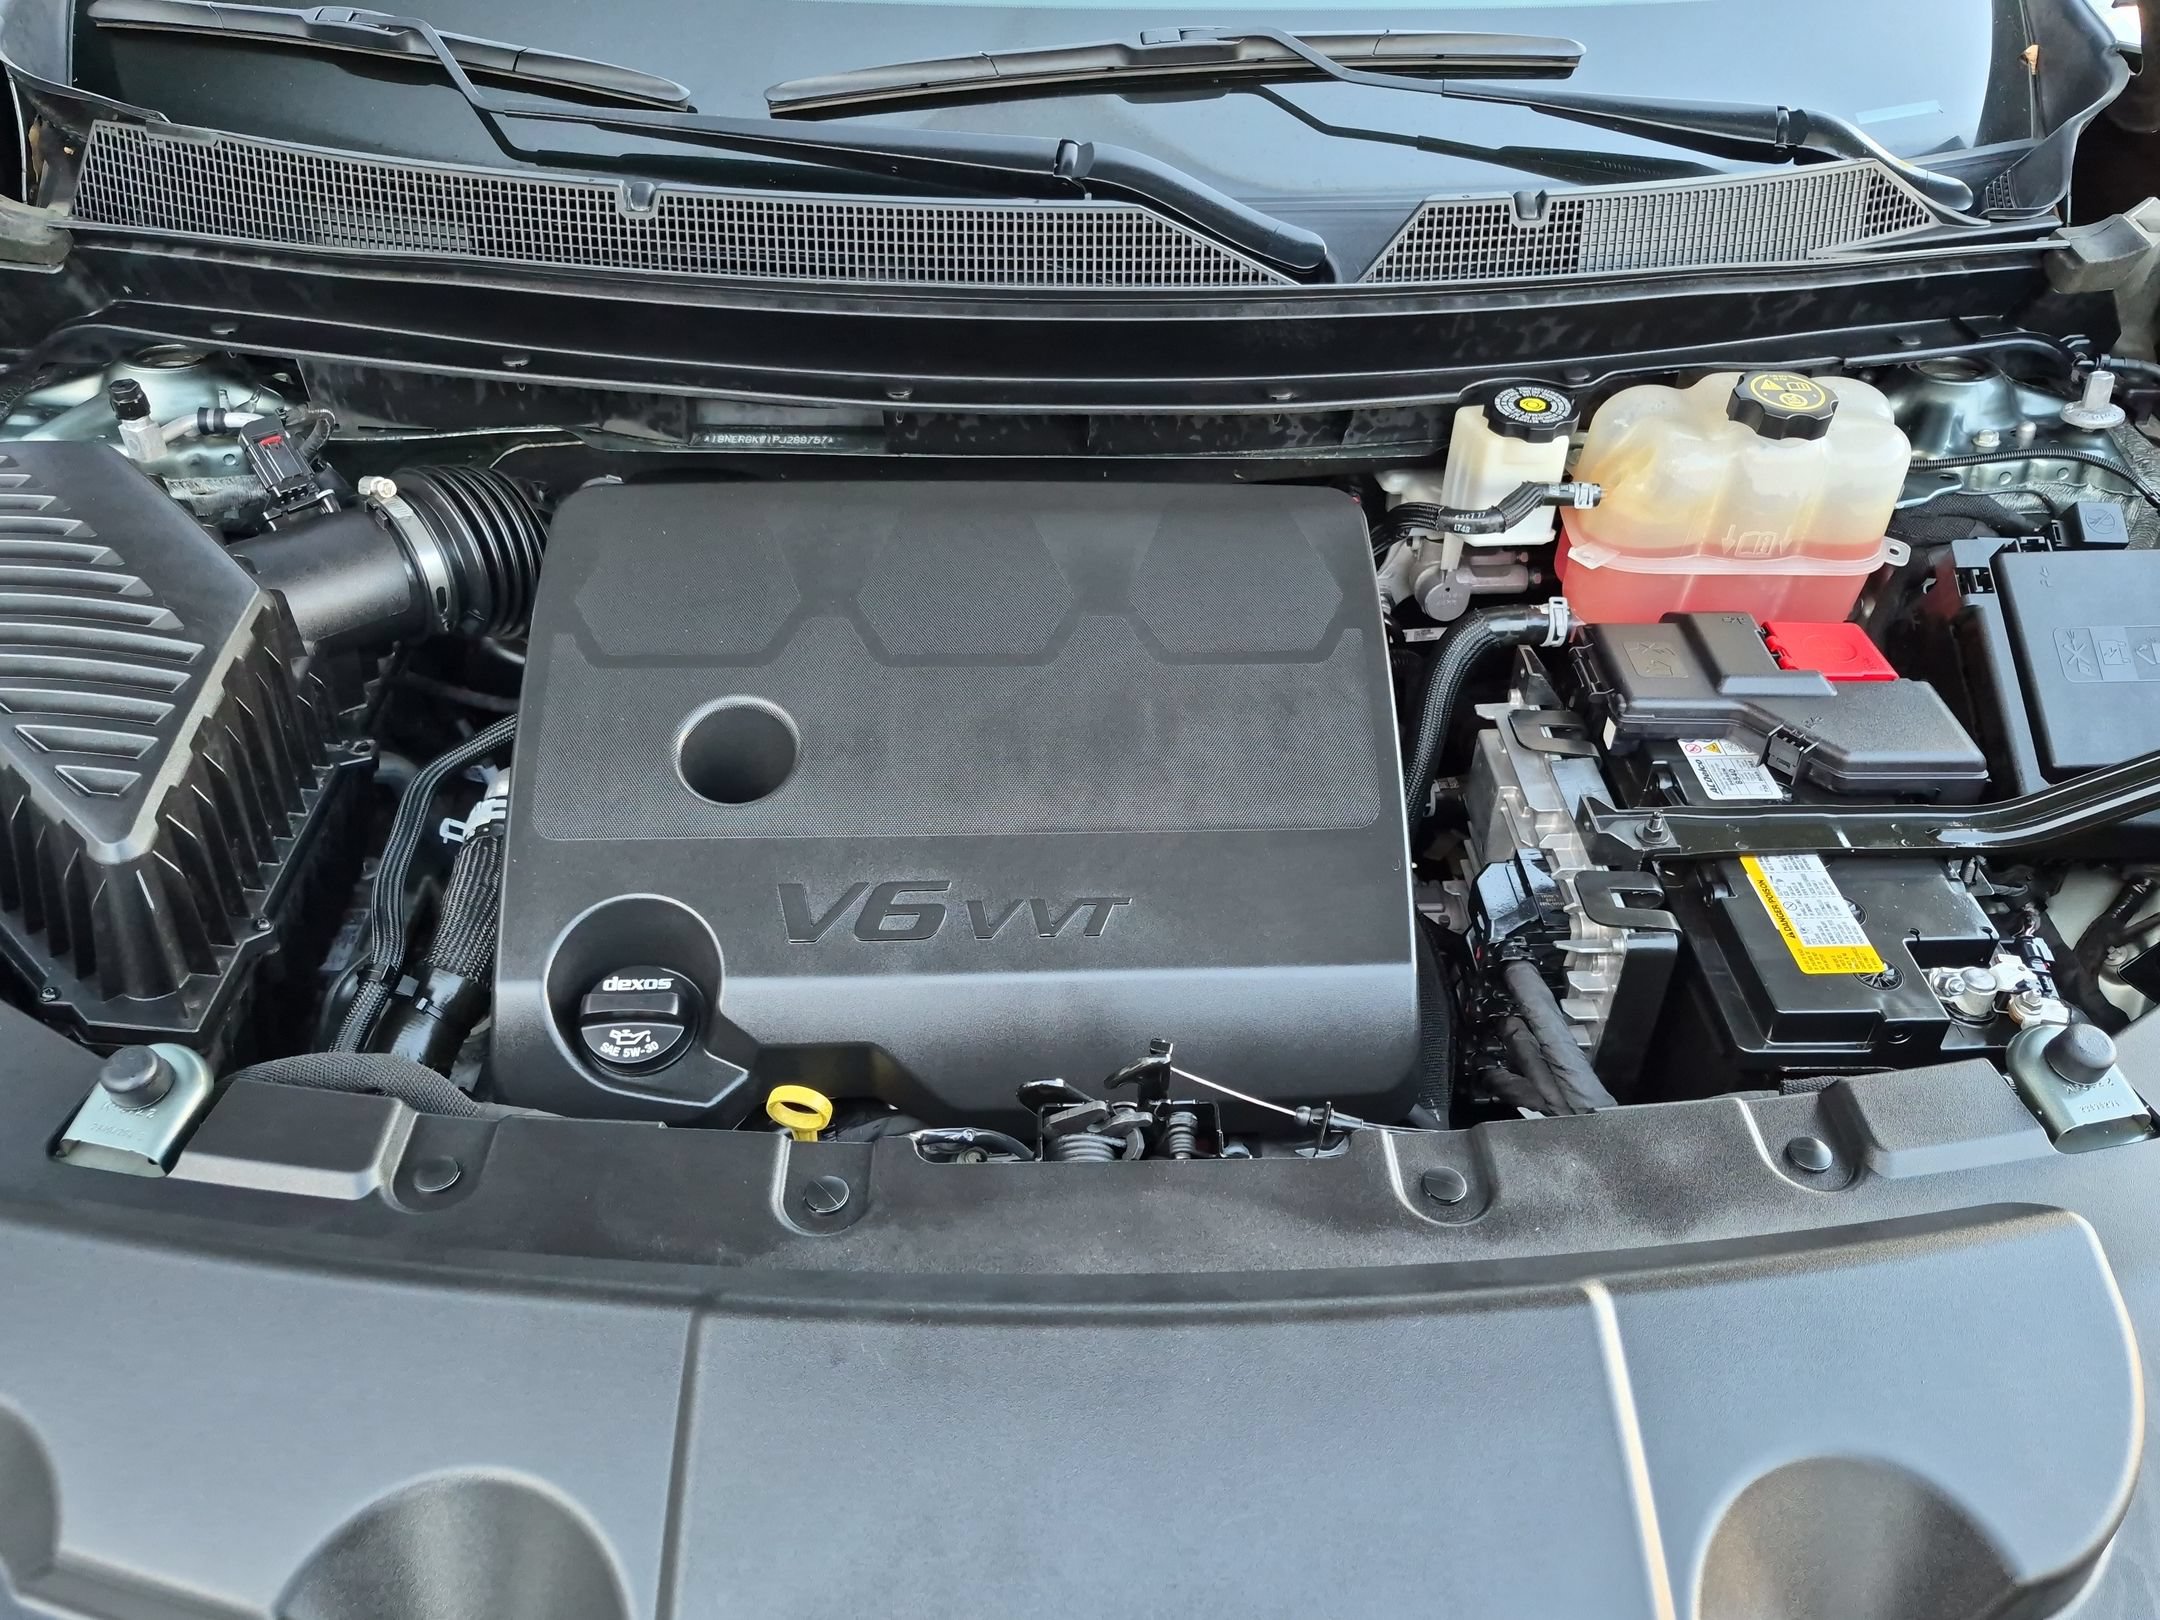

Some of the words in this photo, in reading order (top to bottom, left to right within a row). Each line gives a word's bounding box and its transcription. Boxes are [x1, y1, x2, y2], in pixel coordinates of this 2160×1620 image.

[778, 880, 951, 944] V6
[966, 897, 1133, 940] VVT
[603, 976, 675, 992] dexos
[600, 1042, 621, 1057] SAE
[622, 1041, 660, 1058] 5W-30
